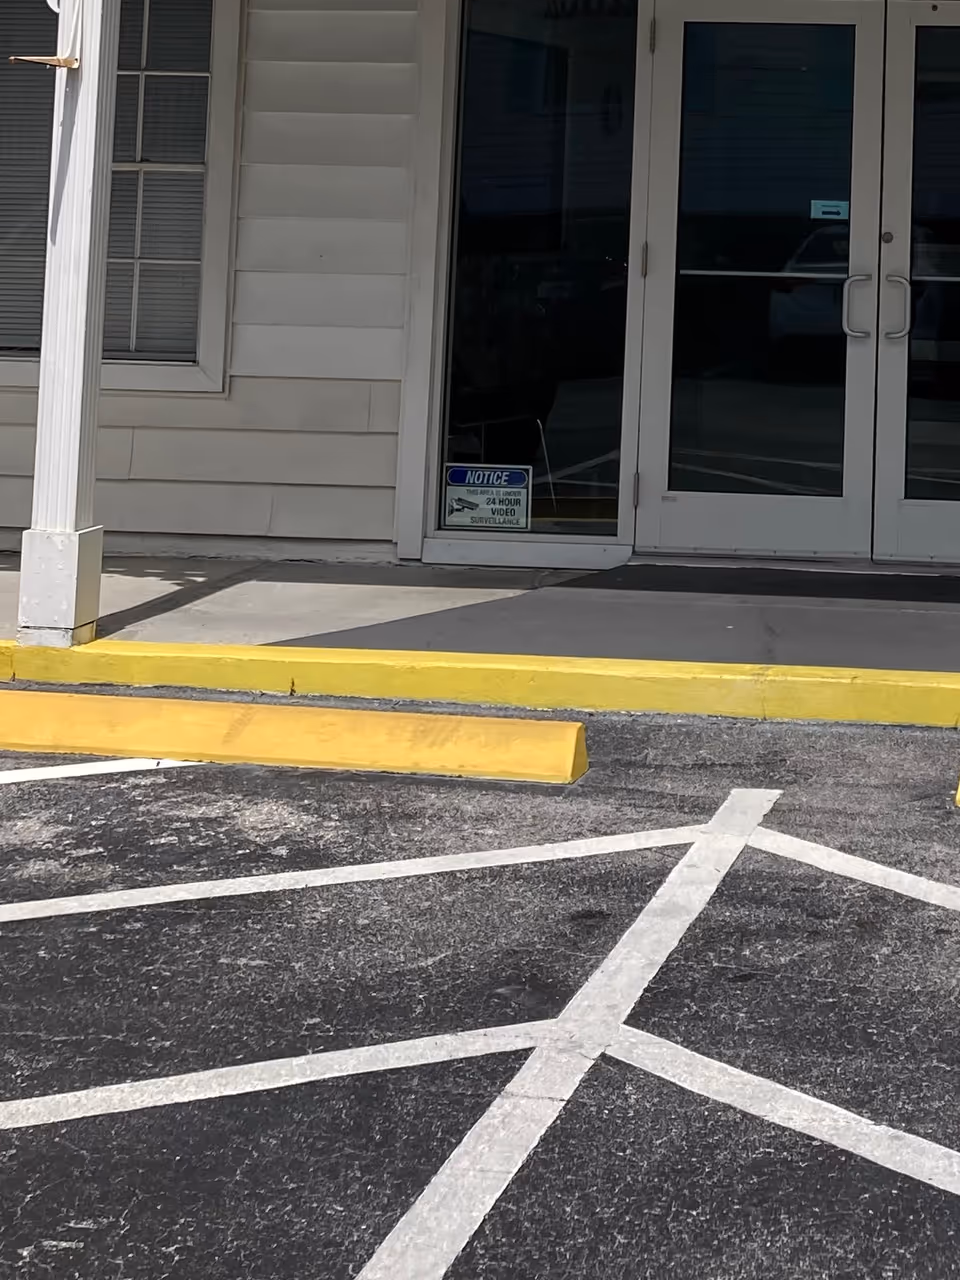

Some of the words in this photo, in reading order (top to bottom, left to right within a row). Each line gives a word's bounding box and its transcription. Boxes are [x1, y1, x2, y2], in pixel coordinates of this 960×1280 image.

[465, 470, 510, 485] NOTICE
[486, 497, 496, 506] 24
[499, 498, 521, 507] HOUR
[491, 508, 516, 517] VIDEO
[470, 516, 521, 526] SURVEILLANCE
